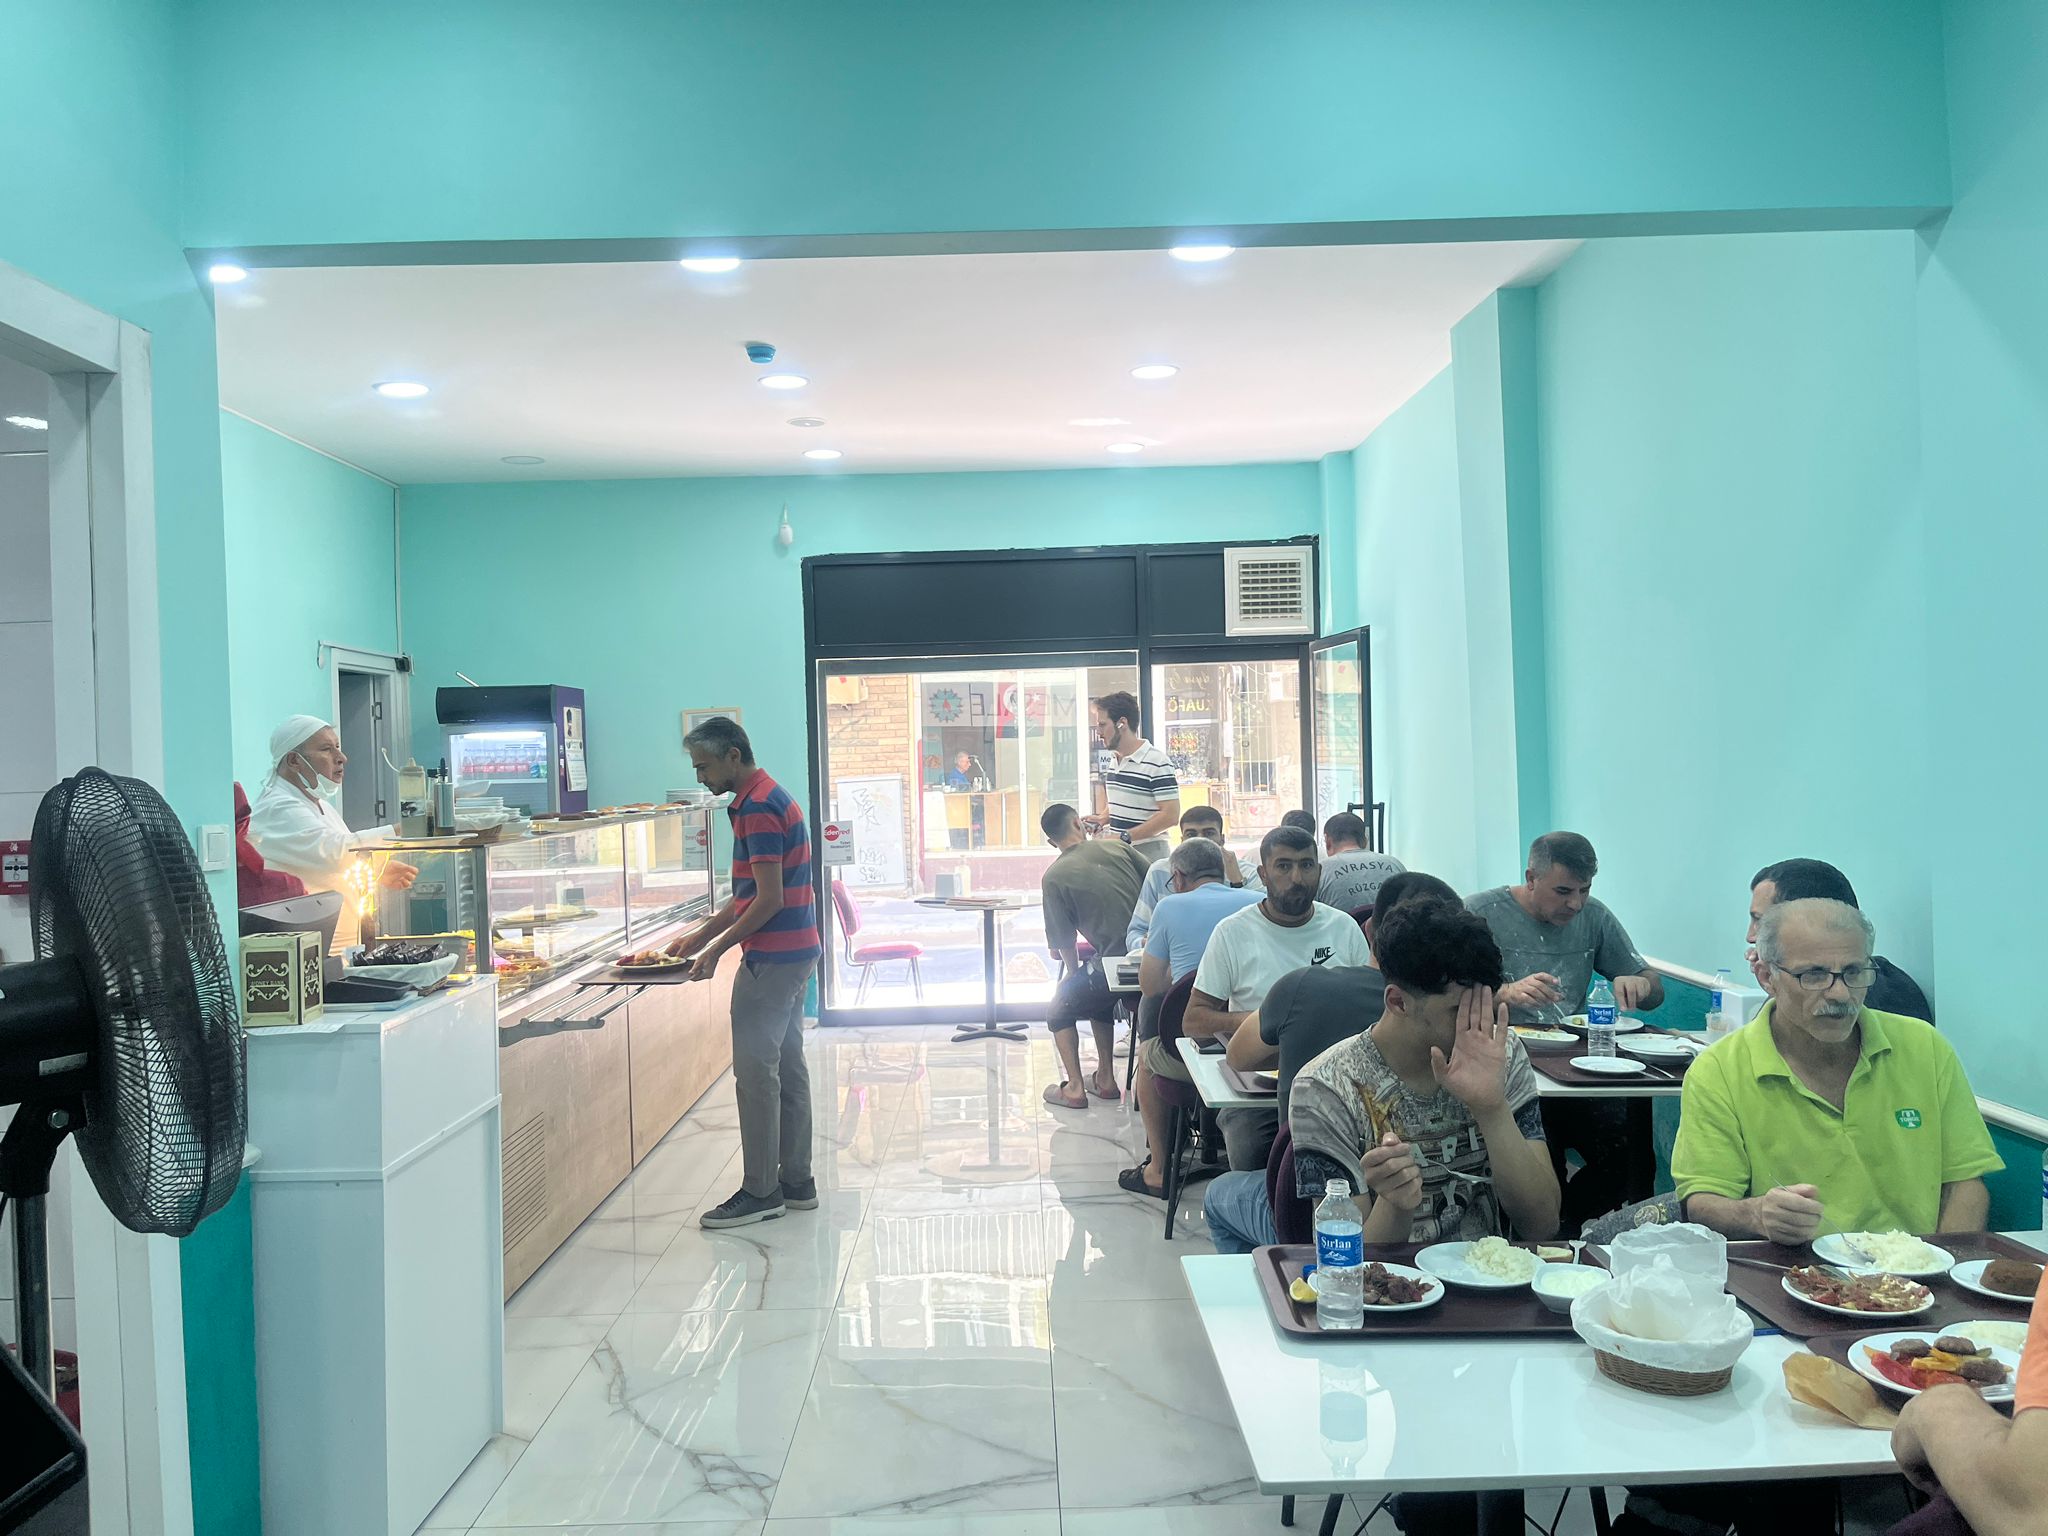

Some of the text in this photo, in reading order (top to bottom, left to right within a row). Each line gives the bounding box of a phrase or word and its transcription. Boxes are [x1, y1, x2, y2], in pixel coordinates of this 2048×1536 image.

[1334, 861, 1393, 879] AVRASYA
[1348, 882, 1384, 896] RÜZGA
[1314, 946, 1332, 959] NIKE
